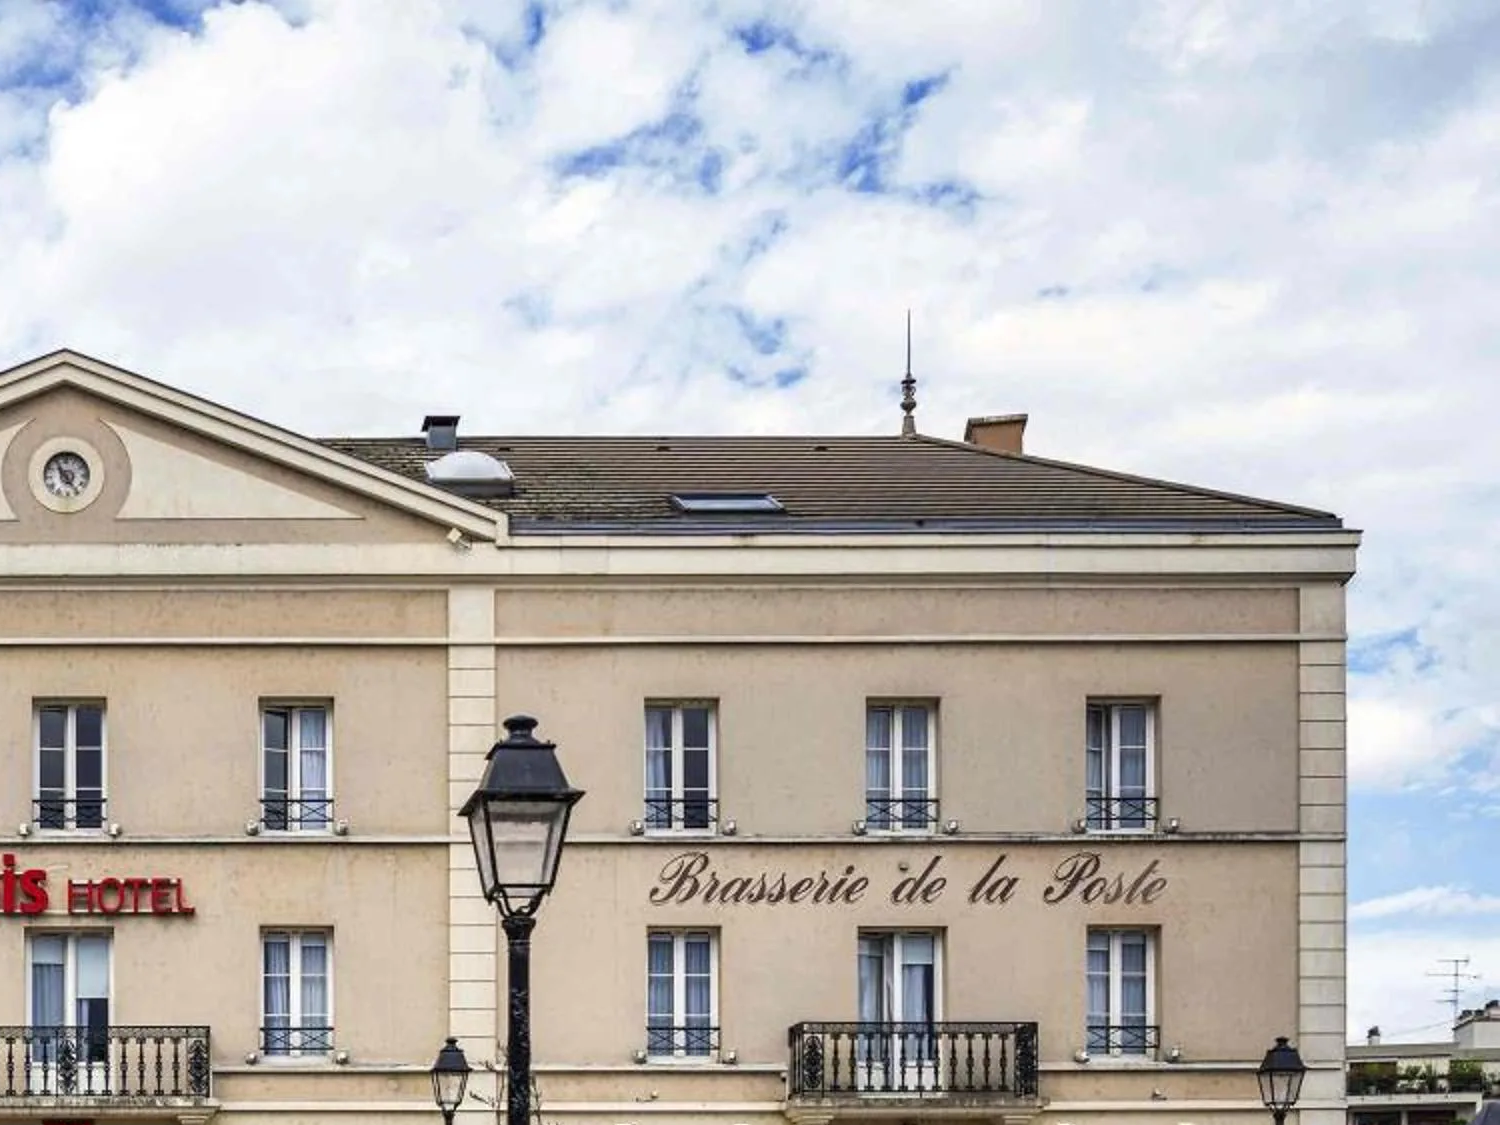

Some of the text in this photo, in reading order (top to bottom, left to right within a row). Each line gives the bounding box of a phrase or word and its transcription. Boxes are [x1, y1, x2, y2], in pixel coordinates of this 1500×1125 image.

[67, 877, 196, 915] HOTEL
[649, 851, 1169, 905] Brasserie de la Poste
